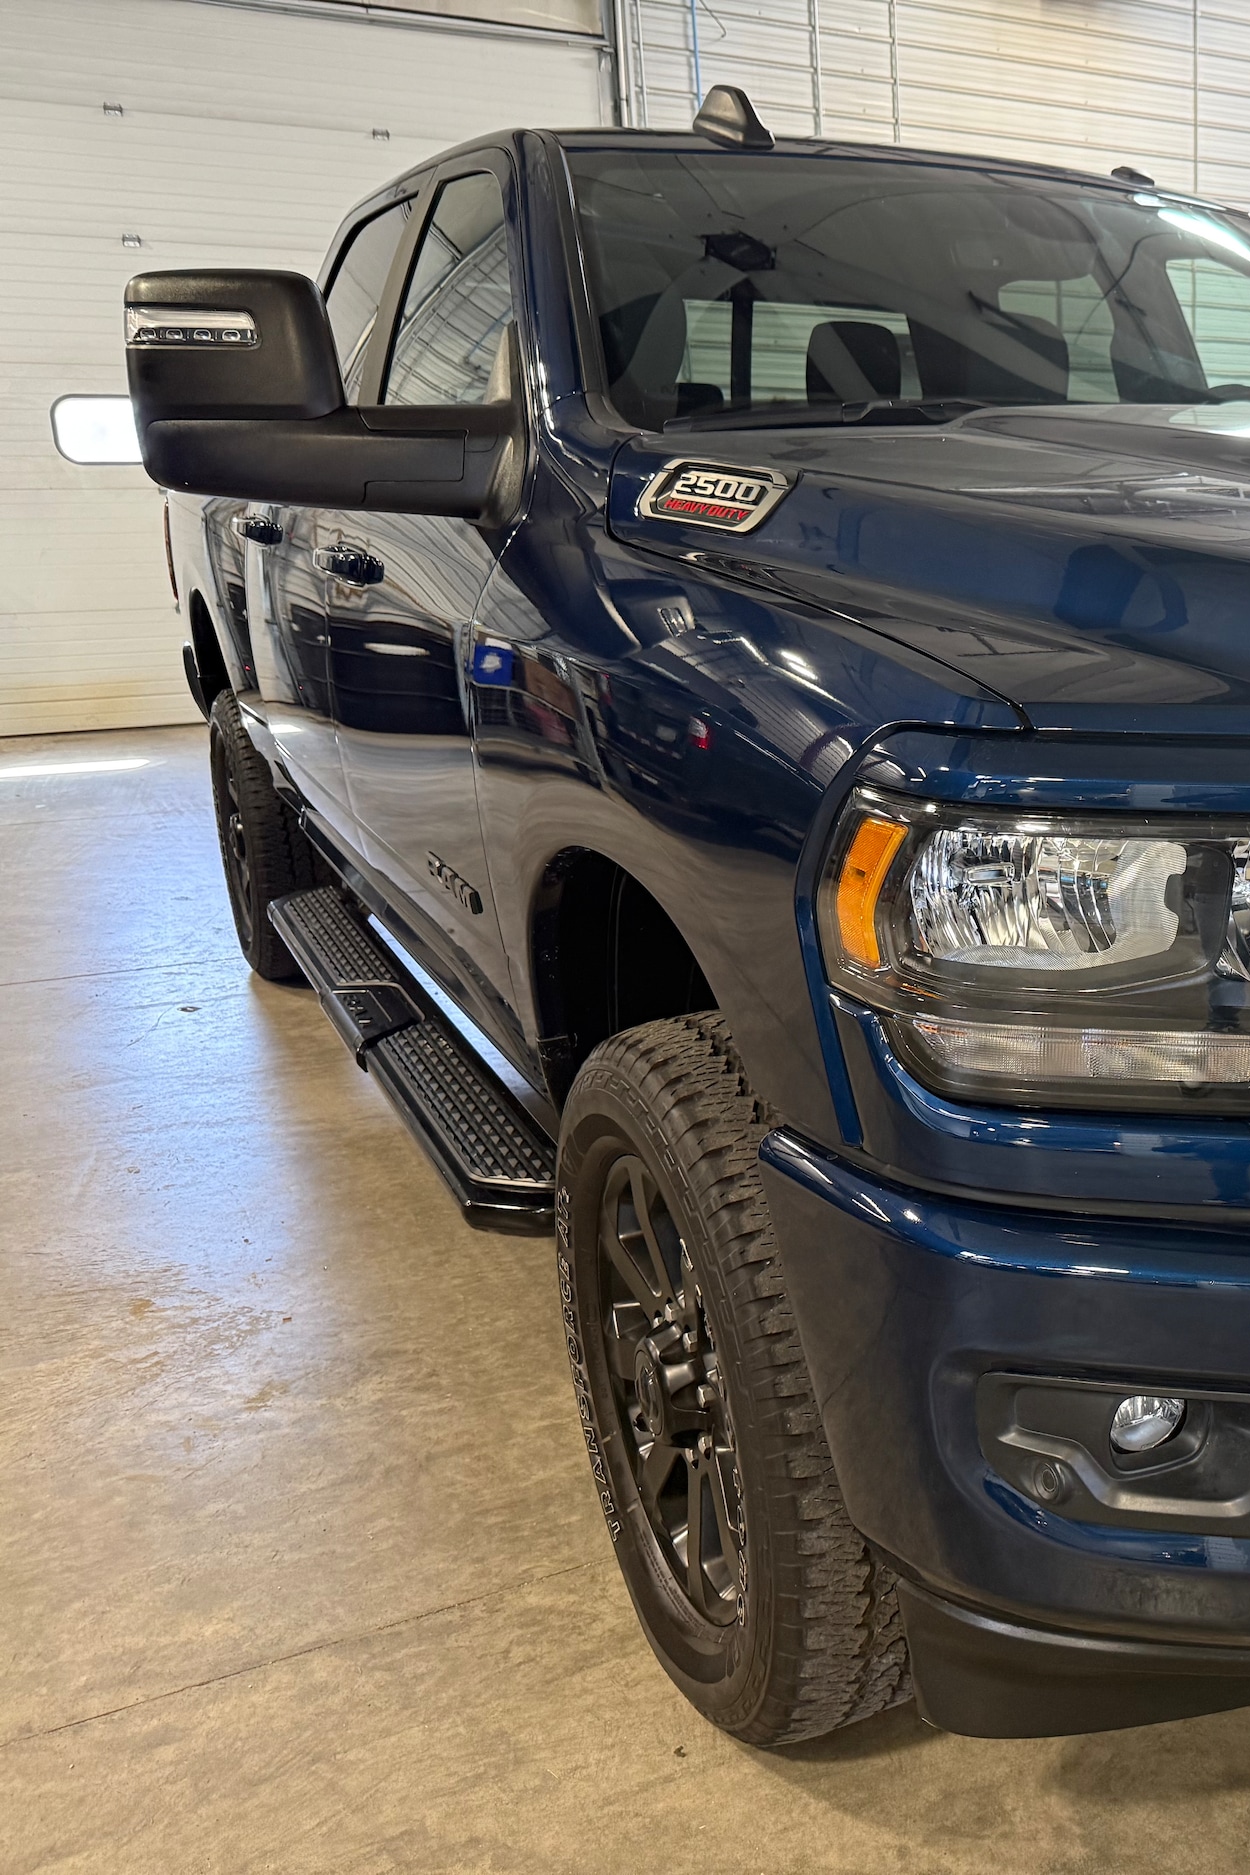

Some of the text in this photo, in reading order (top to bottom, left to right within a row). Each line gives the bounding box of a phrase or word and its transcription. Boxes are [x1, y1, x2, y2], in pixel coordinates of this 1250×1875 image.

[675, 473, 760, 502] 2500
[664, 498, 749, 520] HEAVY DUTY
[558, 1251, 621, 1542] TRANSFORCE
